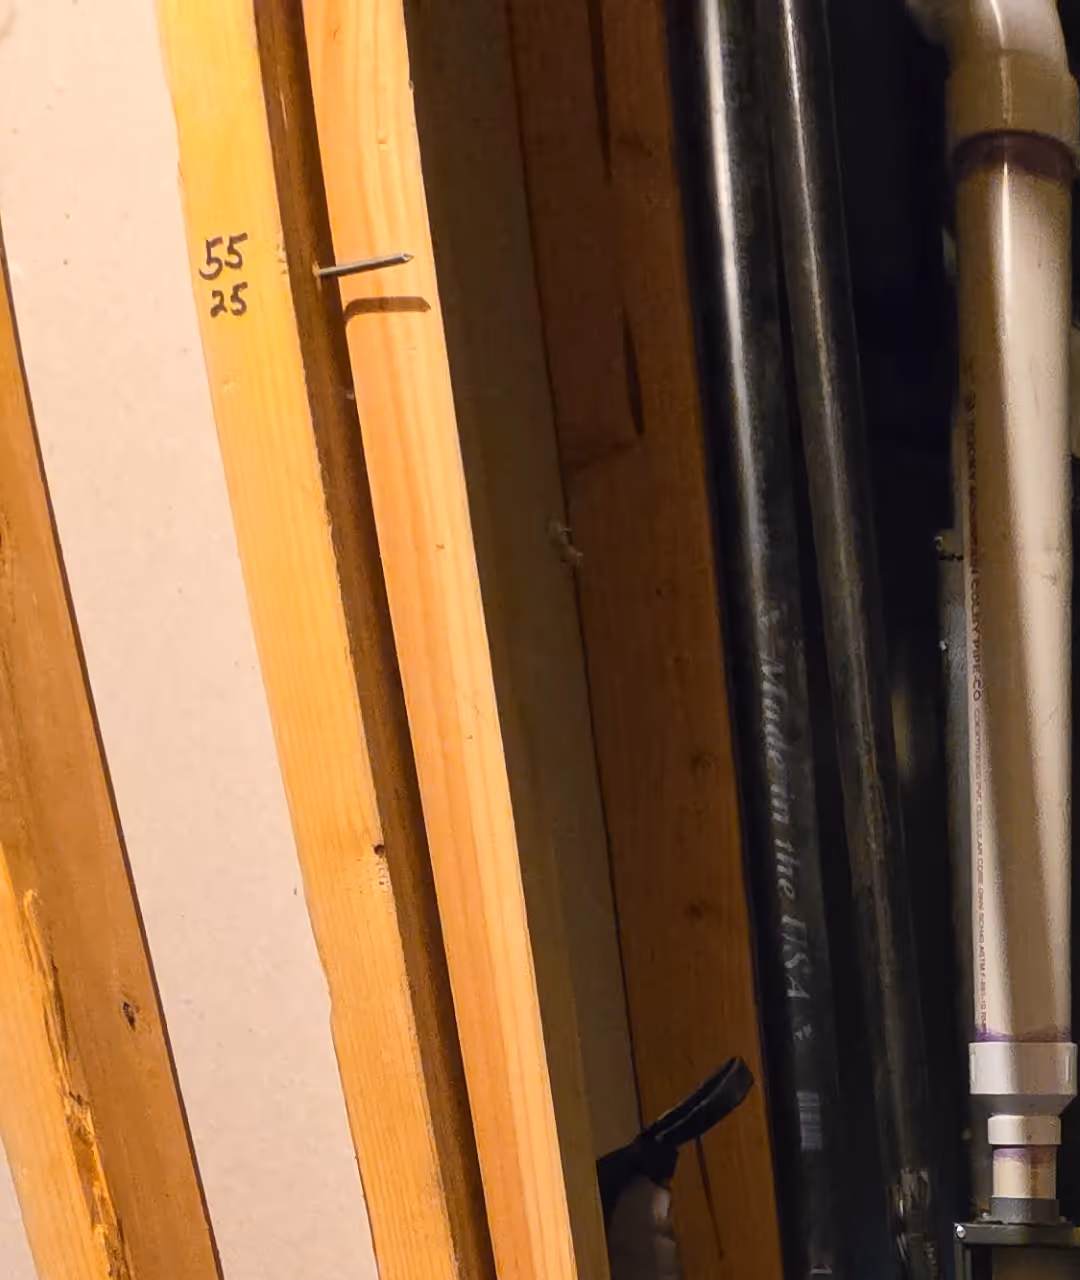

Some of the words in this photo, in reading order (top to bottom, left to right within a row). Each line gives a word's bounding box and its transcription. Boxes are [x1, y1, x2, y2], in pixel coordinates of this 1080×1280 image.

[198, 231, 249, 281] 55
[209, 280, 249, 319] 25
[774, 838, 801, 900] the
[780, 911, 812, 999] USA
